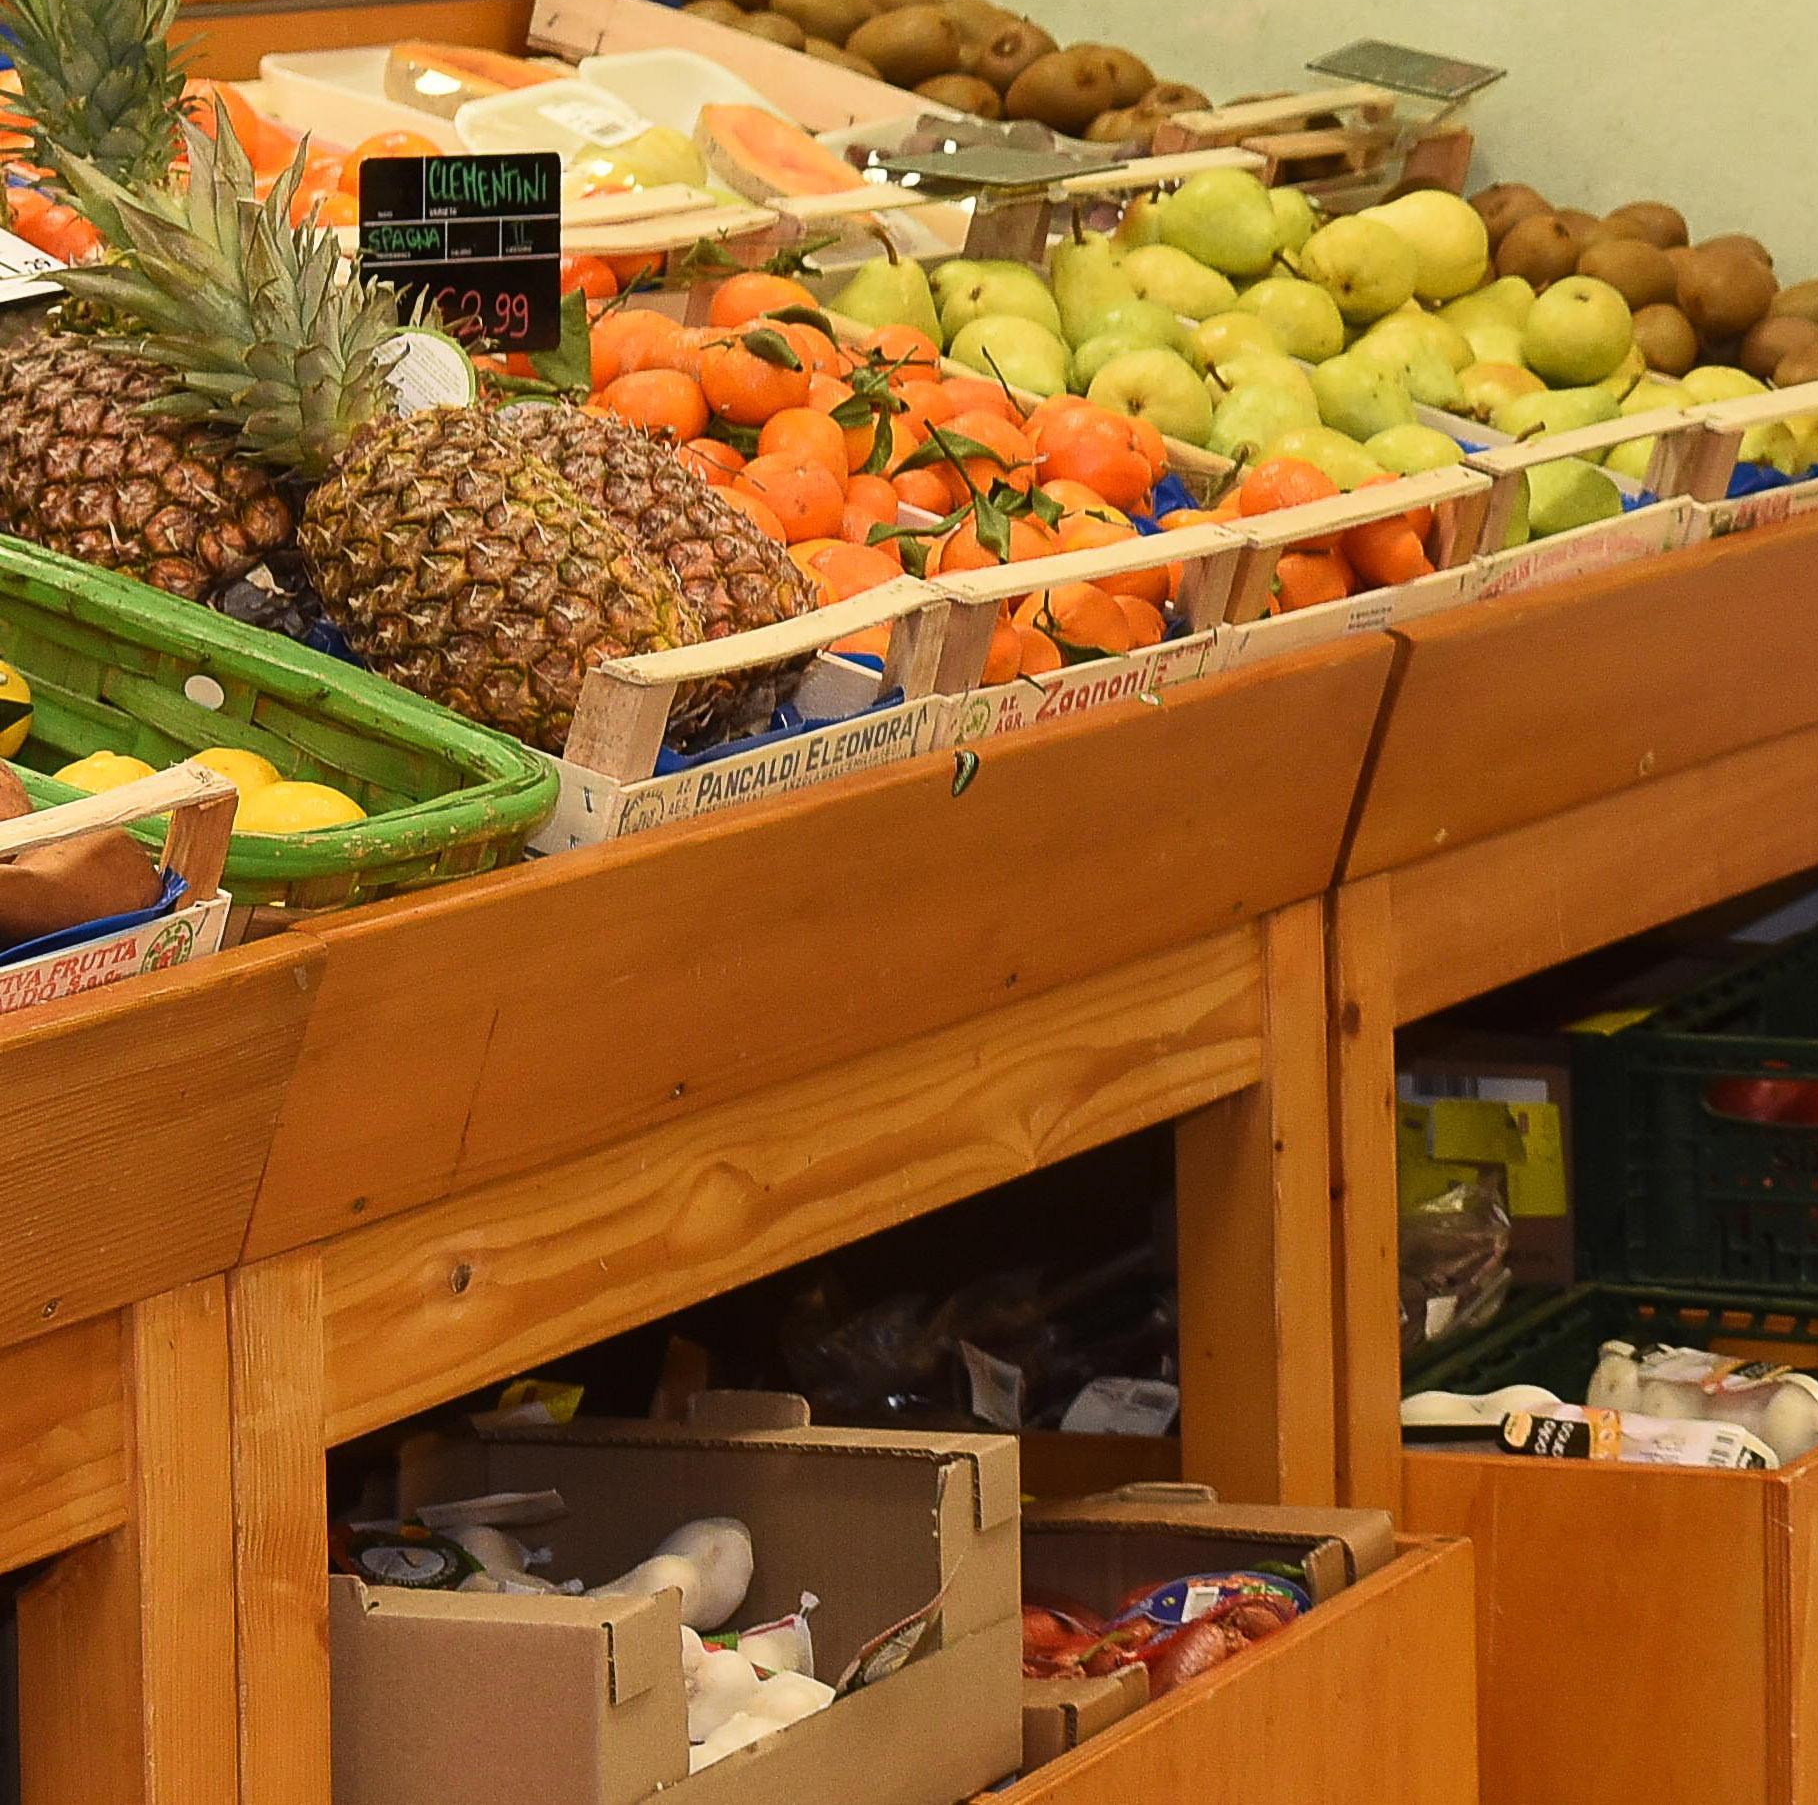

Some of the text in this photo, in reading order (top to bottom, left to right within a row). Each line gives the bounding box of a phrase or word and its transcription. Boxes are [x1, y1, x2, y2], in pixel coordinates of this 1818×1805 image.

[428, 158, 548, 210] CLEMENTINI
[368, 224, 441, 252] SPAGNA
[696, 749, 800, 808] PANCALDI
[805, 711, 914, 772] ELEONORA
[49, 937, 137, 983] FRUTTA
[0, 982, 57, 1013] LDO
